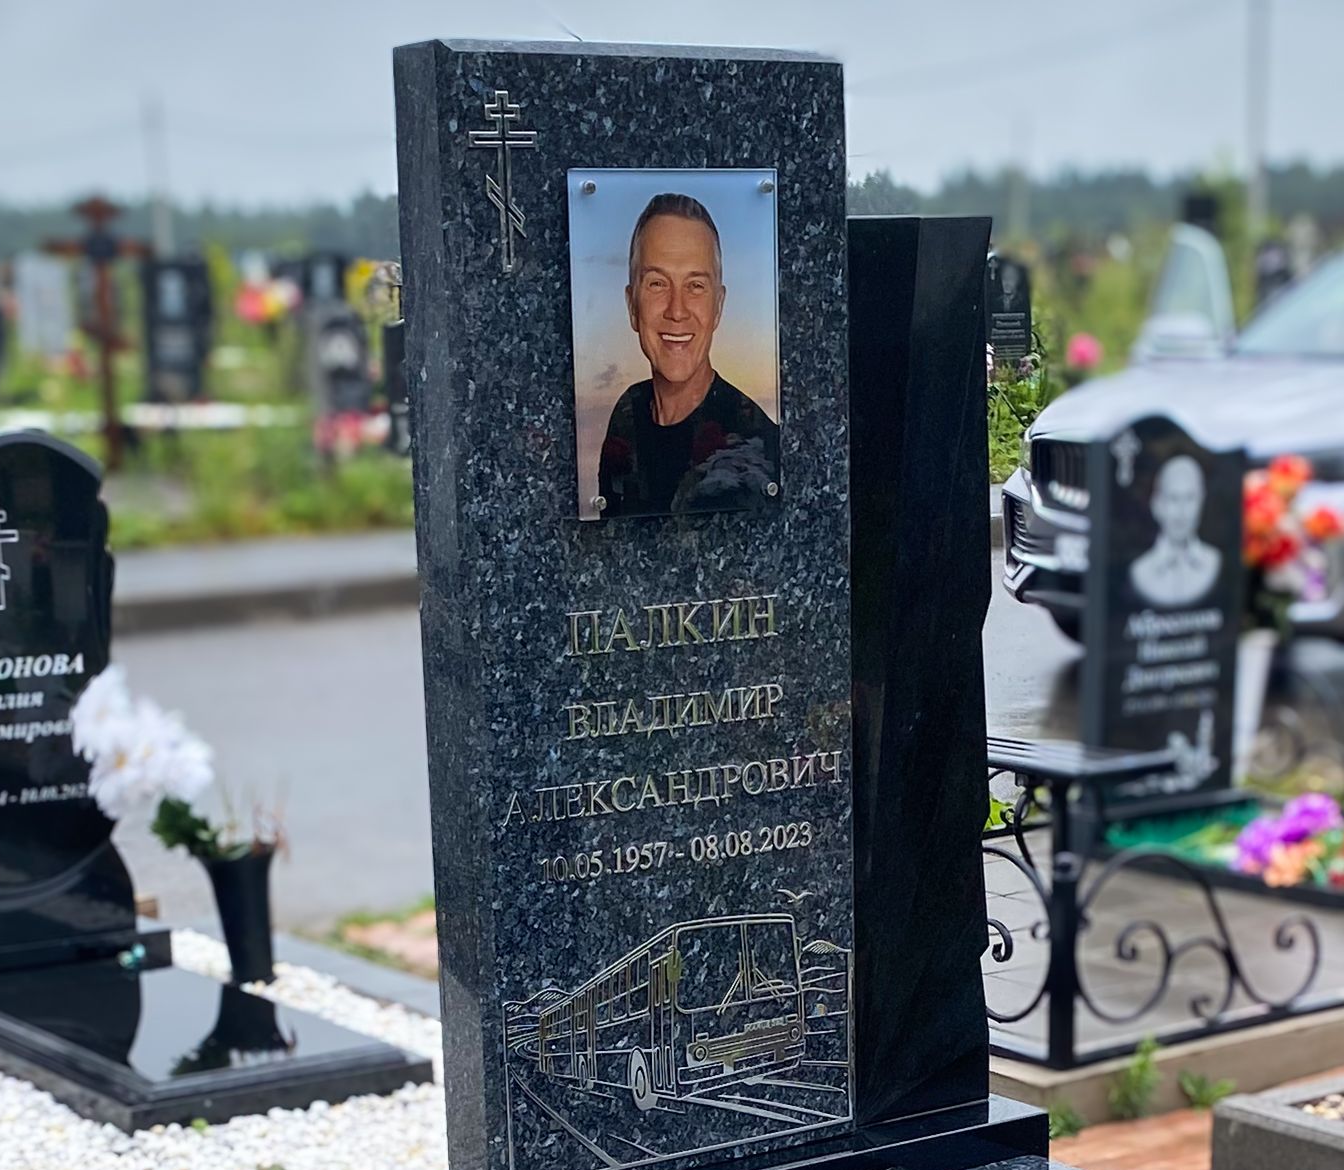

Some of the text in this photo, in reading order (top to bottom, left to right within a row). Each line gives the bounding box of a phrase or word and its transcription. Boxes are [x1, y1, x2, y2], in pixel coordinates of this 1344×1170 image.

[565, 594, 778, 656] ПАЛКИН
[563, 683, 784, 740] ВЛАДИМИР
[501, 750, 843, 827] АЛЕКСАНДРОВИЧ
[540, 841, 668, 885] 10.05.1957
[690, 821, 812, 863] 08.08.2023
